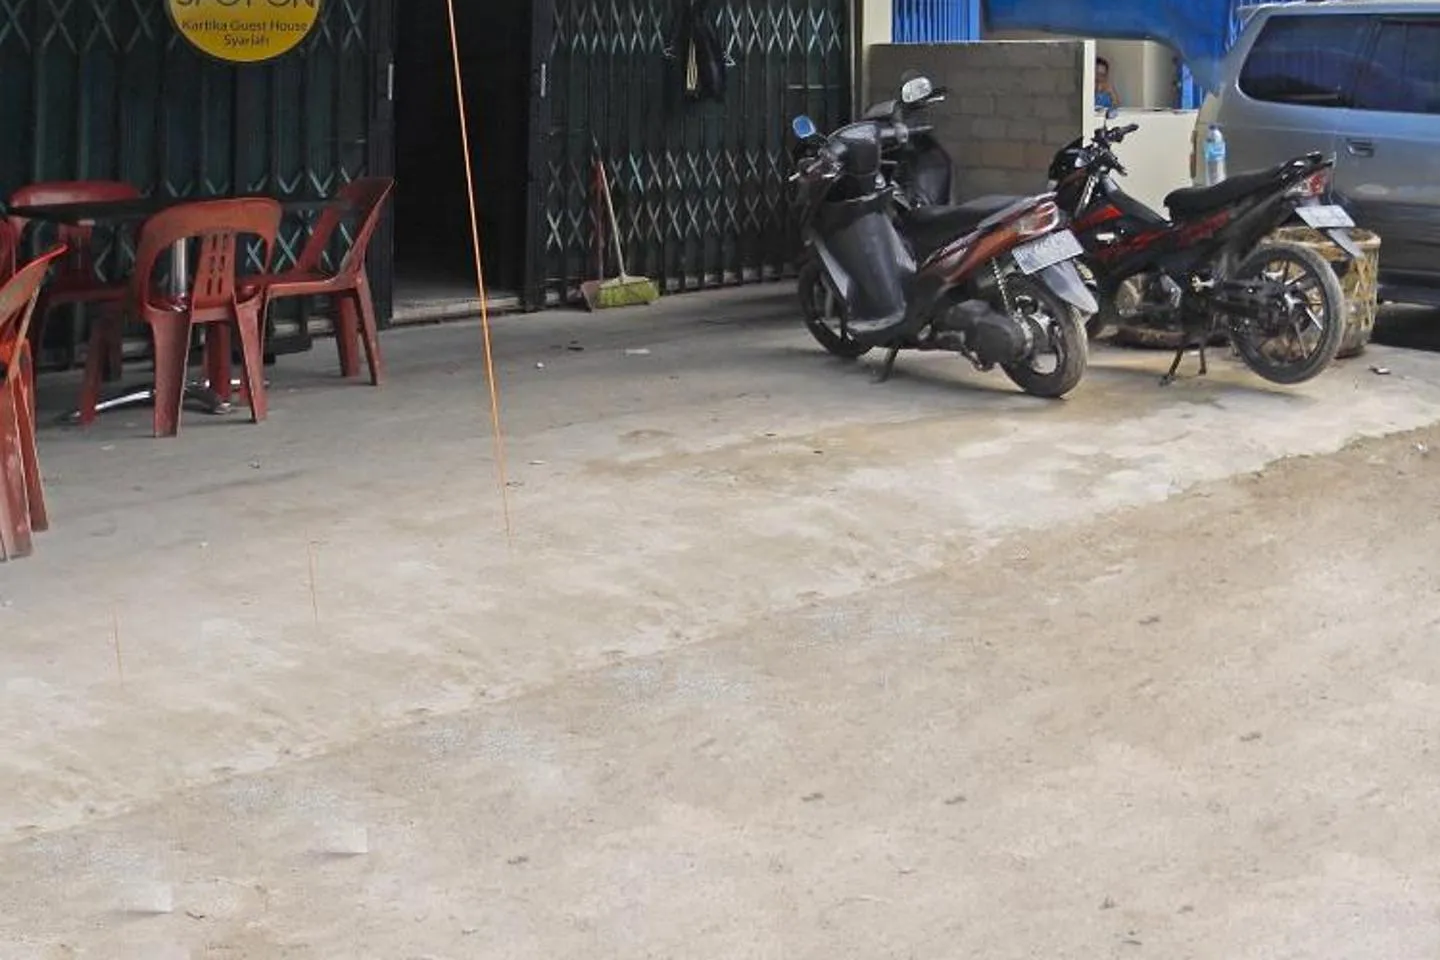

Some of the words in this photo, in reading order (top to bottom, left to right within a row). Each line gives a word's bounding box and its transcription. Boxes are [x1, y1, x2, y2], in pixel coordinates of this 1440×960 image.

[182, 18, 228, 32] Kartika
[229, 19, 267, 33] Guest
[270, 19, 309, 33] House
[223, 33, 270, 49] Syariah
